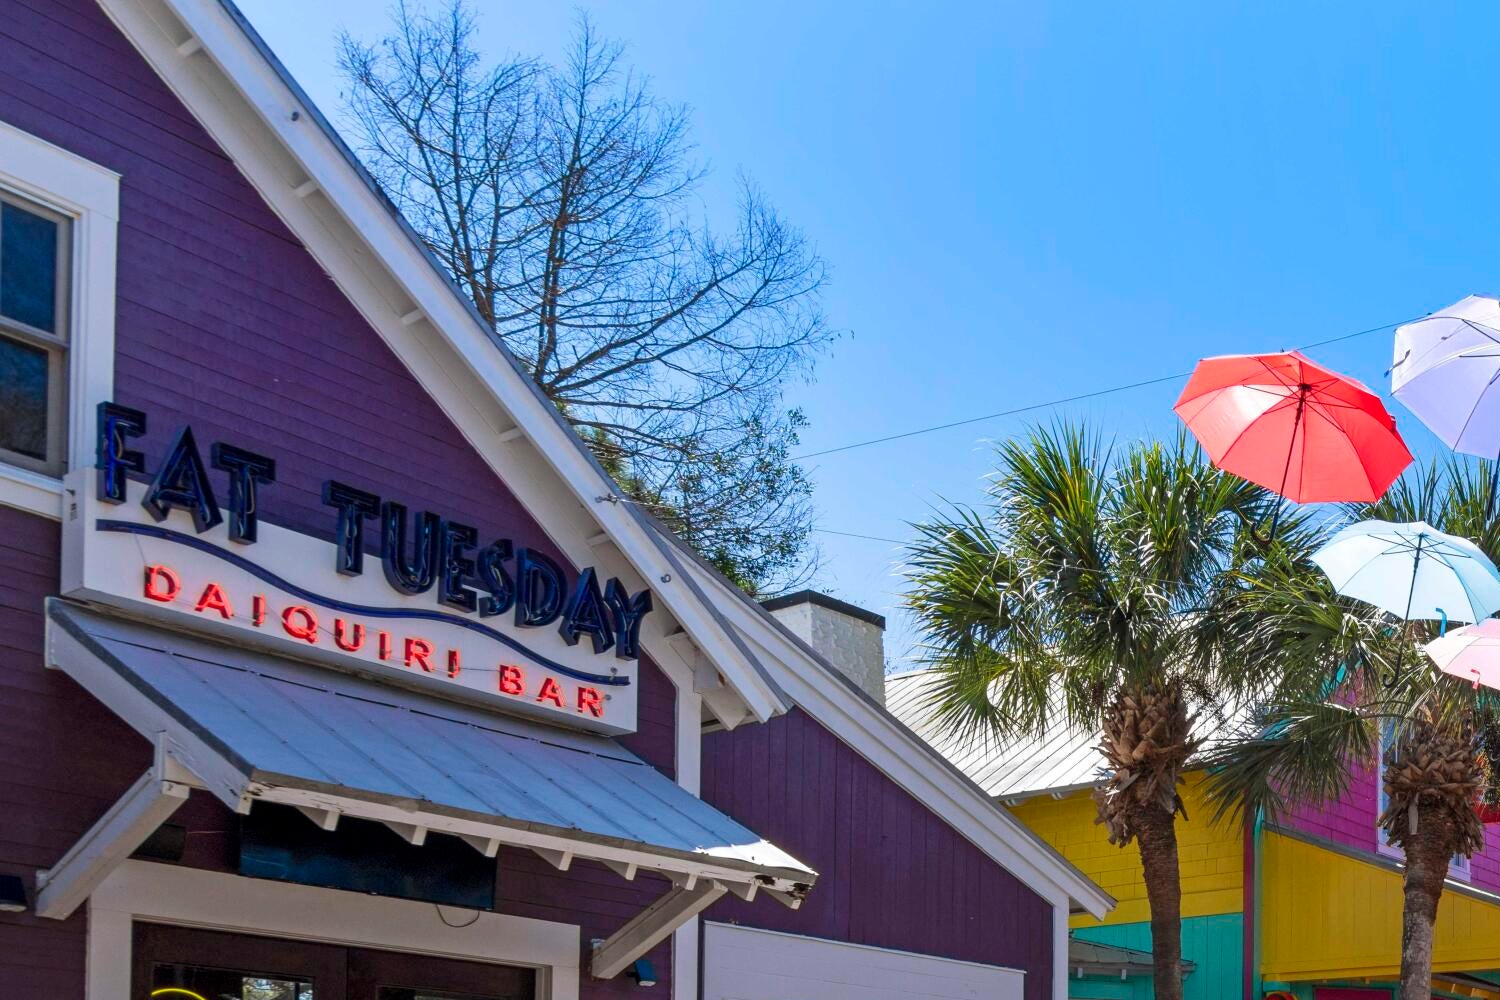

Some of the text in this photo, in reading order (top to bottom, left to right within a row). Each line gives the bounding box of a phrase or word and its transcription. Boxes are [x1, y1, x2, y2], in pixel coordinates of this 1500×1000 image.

[96, 401, 654, 661] FAT TUESDAY
[143, 563, 605, 718] DAIQUIRI BAR
